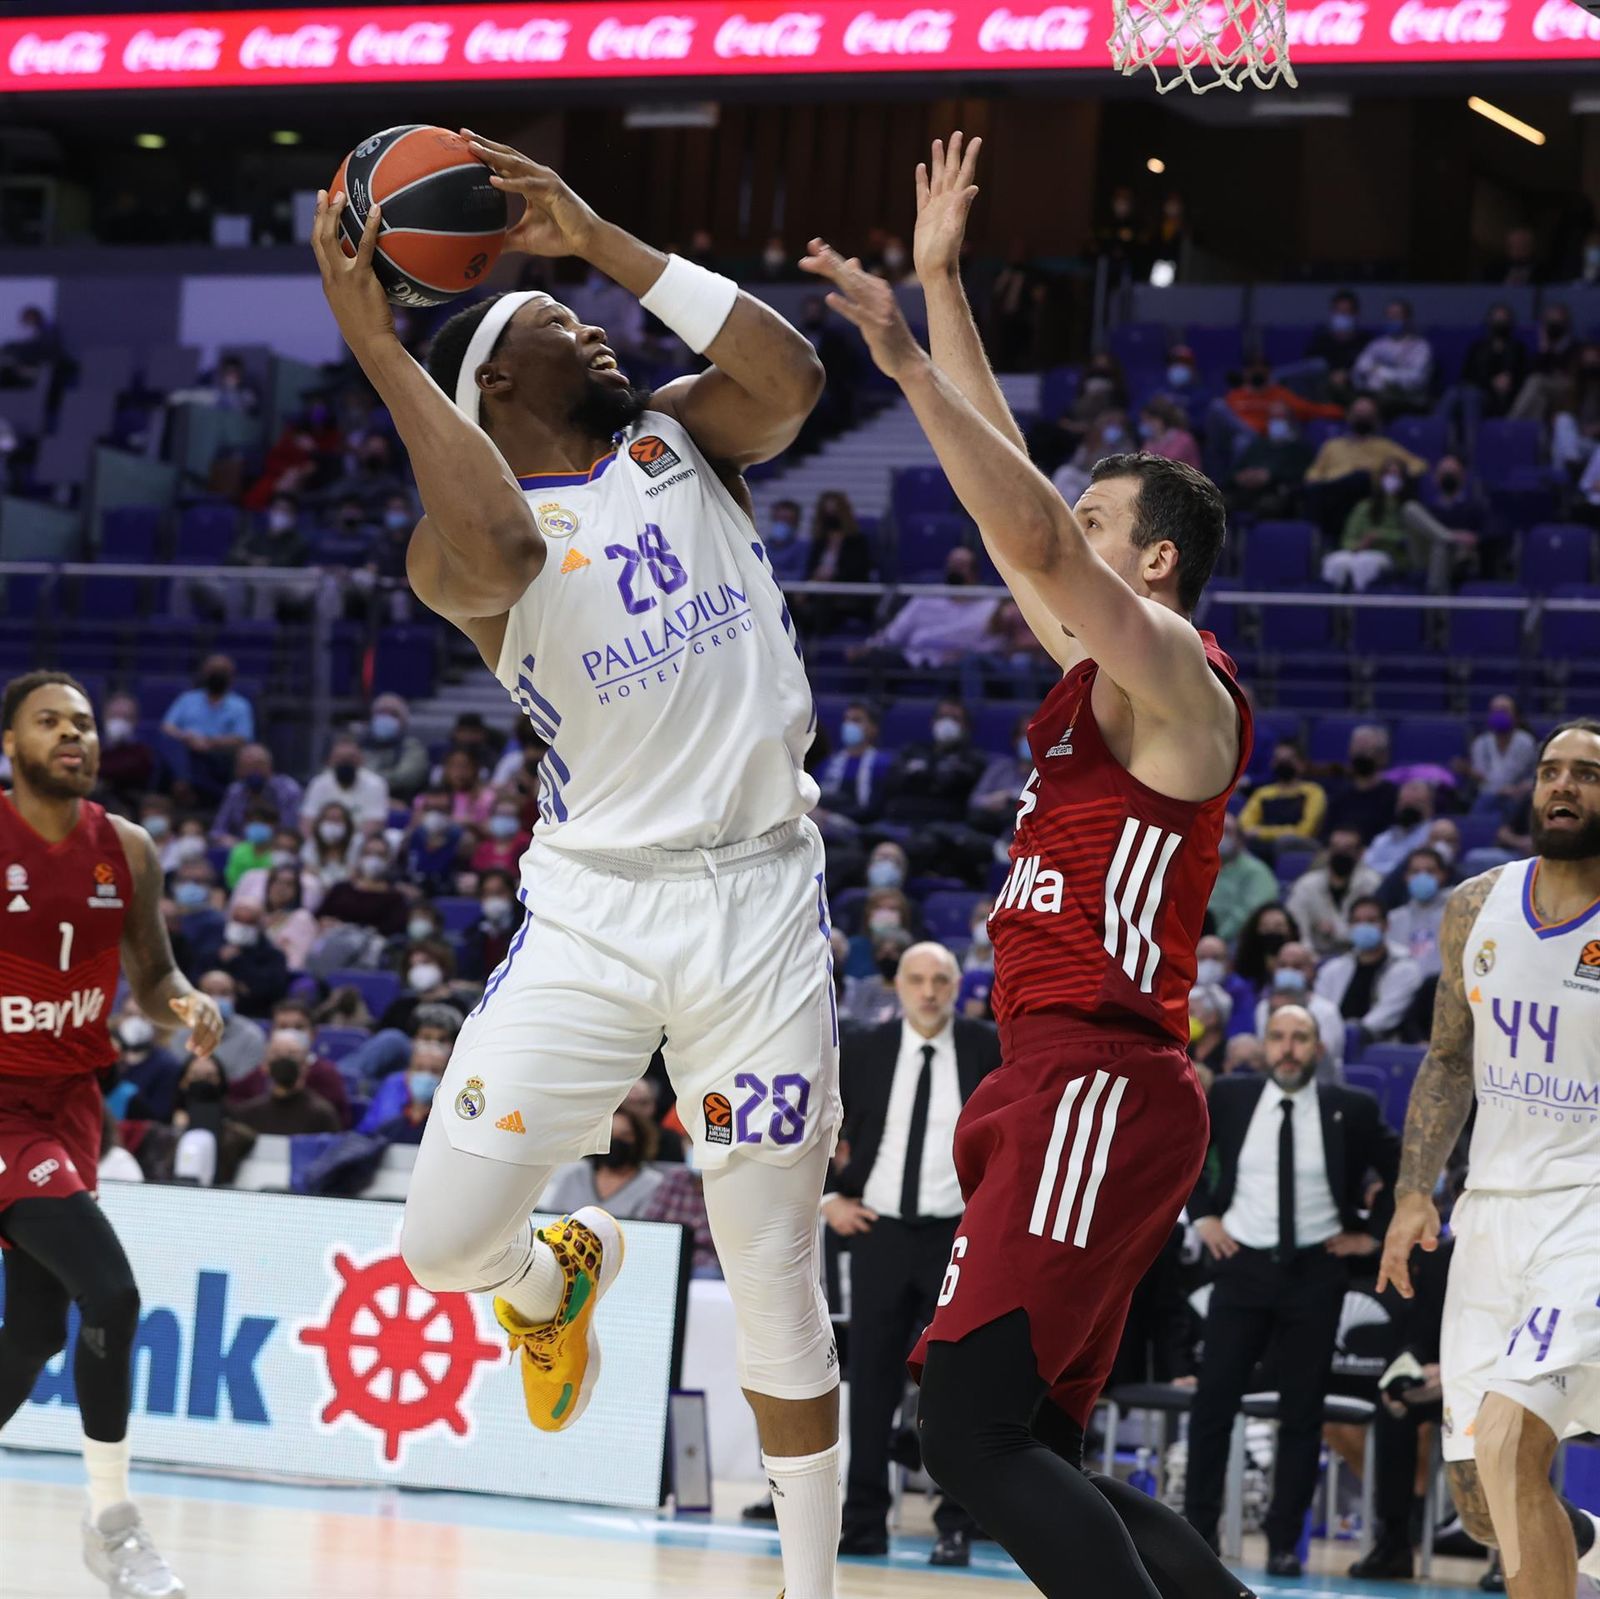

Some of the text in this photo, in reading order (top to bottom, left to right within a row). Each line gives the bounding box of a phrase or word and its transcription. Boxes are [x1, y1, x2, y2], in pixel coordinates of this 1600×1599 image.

[645, 468, 697, 498] 10oneteam
[604, 523, 688, 616] 28
[693, 618, 753, 655] GROU
[988, 855, 1064, 922] yWa
[59, 922, 74, 971] 1
[0, 987, 105, 1038] BayW
[1492, 998, 1559, 1063] 44
[734, 1073, 811, 1145] 28
[937, 1236, 968, 1307] 6
